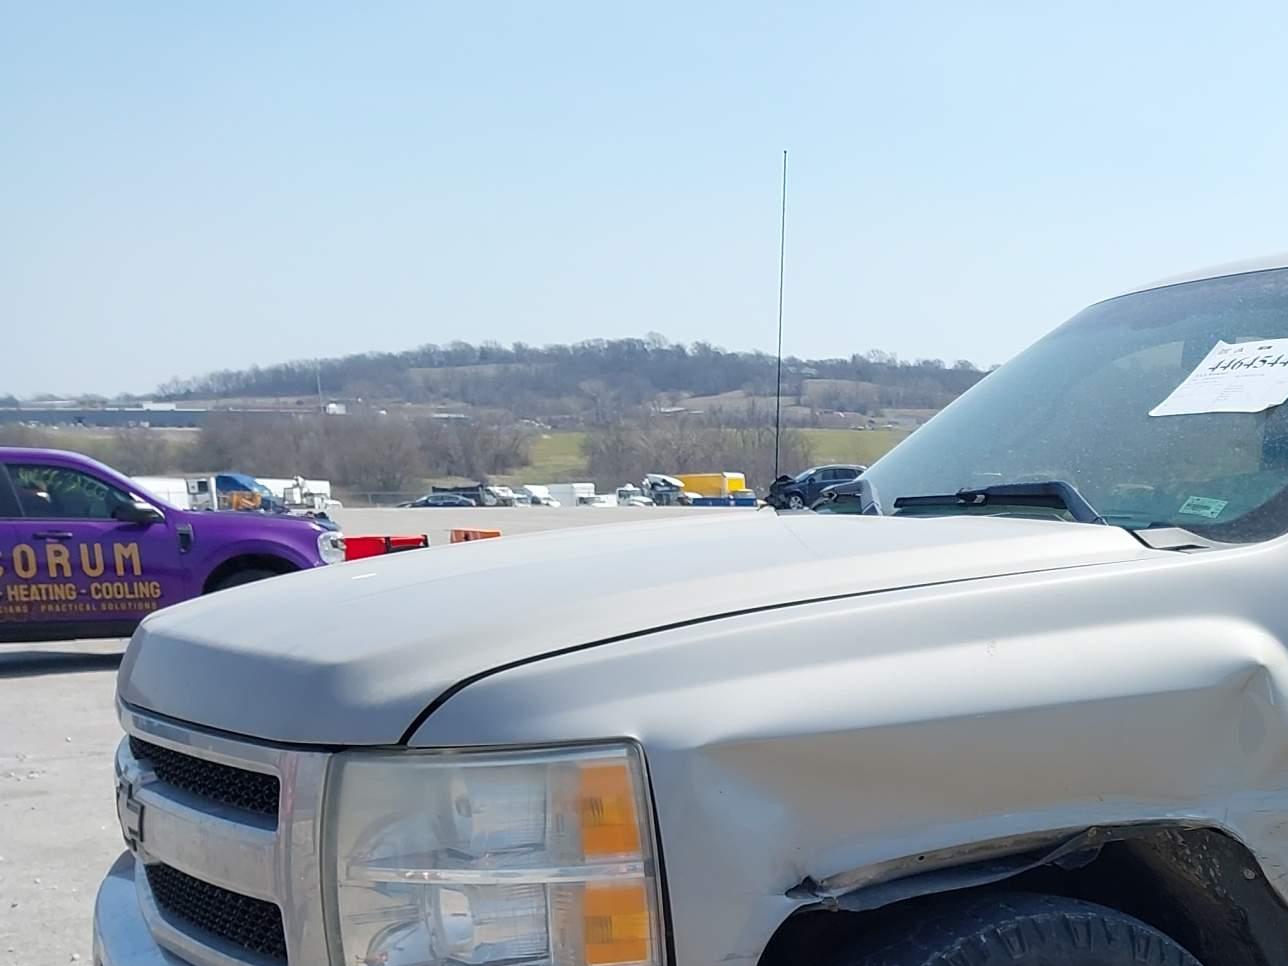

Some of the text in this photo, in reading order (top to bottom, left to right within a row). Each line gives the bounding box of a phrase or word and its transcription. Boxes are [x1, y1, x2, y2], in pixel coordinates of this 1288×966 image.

[7, 582, 77, 602] HEATING
[90, 581, 161, 600] COOLING
[41, 602, 97, 613] PRACTICAL
[101, 601, 158, 612] SOLUTIONS
